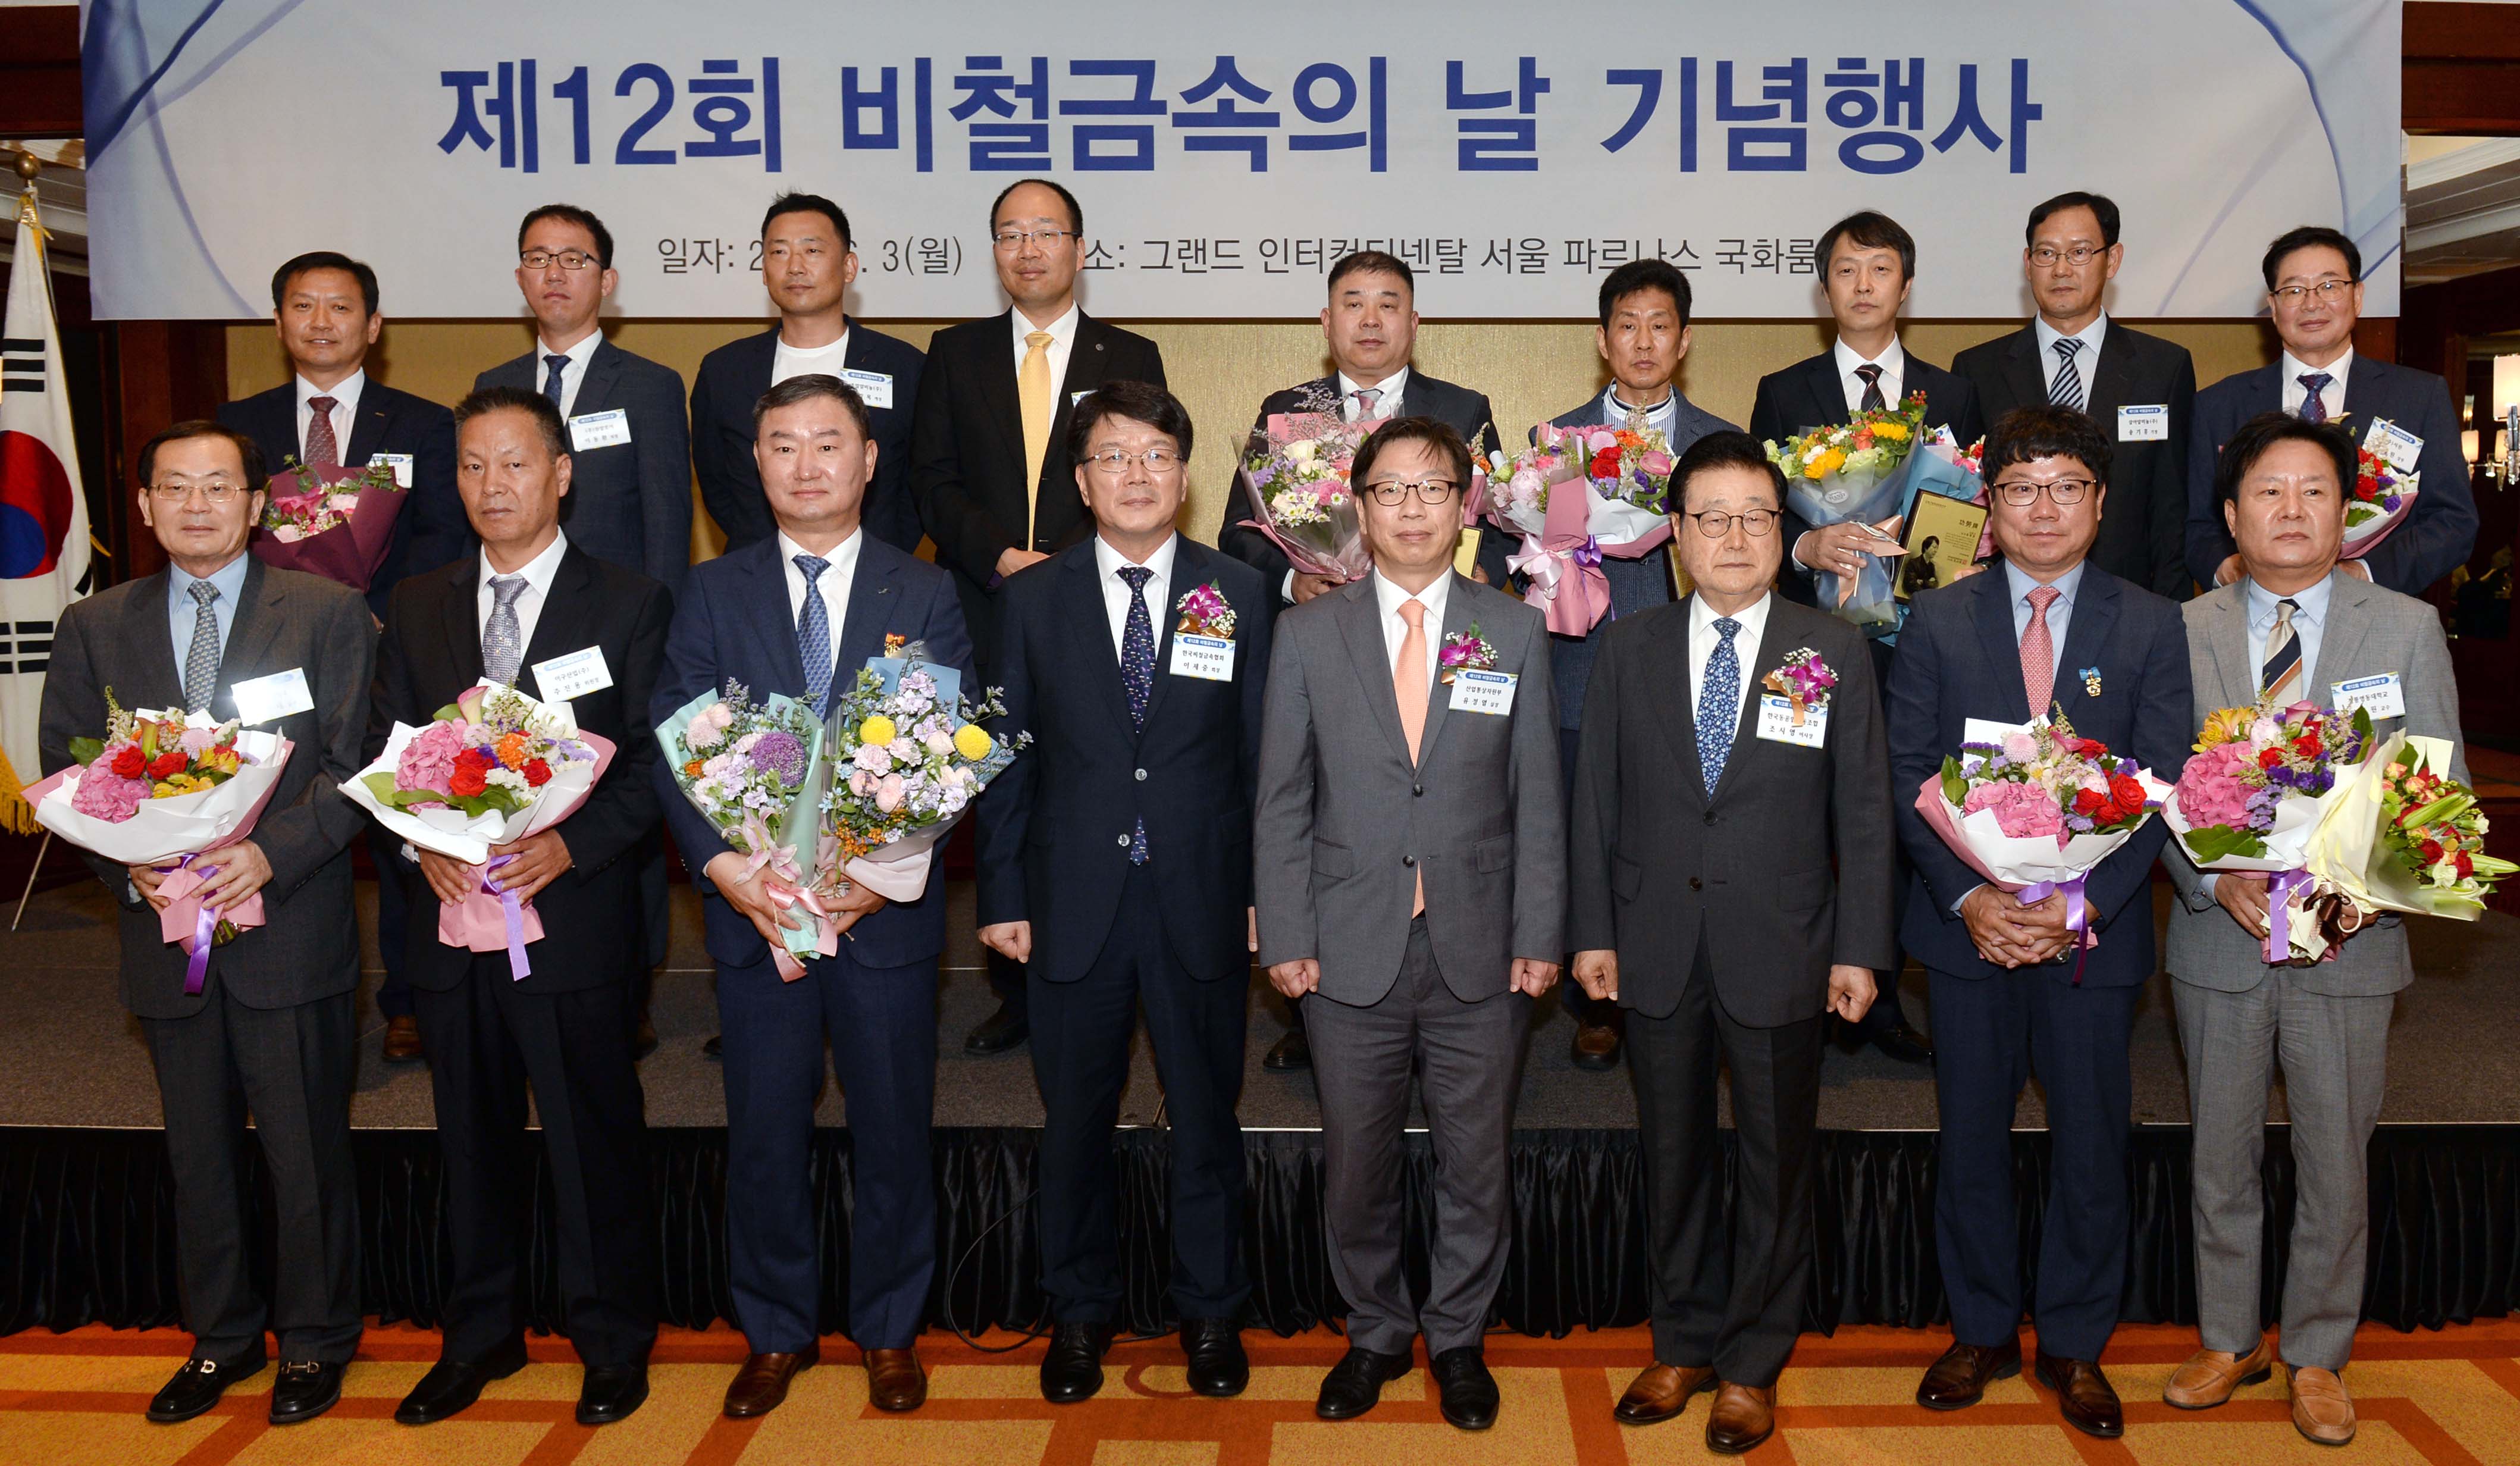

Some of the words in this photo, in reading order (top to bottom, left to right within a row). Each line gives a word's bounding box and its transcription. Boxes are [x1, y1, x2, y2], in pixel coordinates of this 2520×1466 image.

[438, 57, 781, 173] 제12회
[843, 57, 1386, 171] 비철금속의
[1447, 58, 1549, 171] 날
[1602, 58, 2042, 174] 기념행사
[658, 238, 734, 274] 일자:
[883, 236, 961, 275] 3(월)
[1084, 239, 1124, 271] 소:
[1140, 238, 1244, 274] 그랜드
[1481, 238, 1549, 274] 서울
[1715, 238, 1816, 274] 국화룸
[1466, 685, 1503, 696] 산업통상자원부
[1767, 712, 1819, 727] 한국동공조합
[1779, 726, 1785, 735] 시
